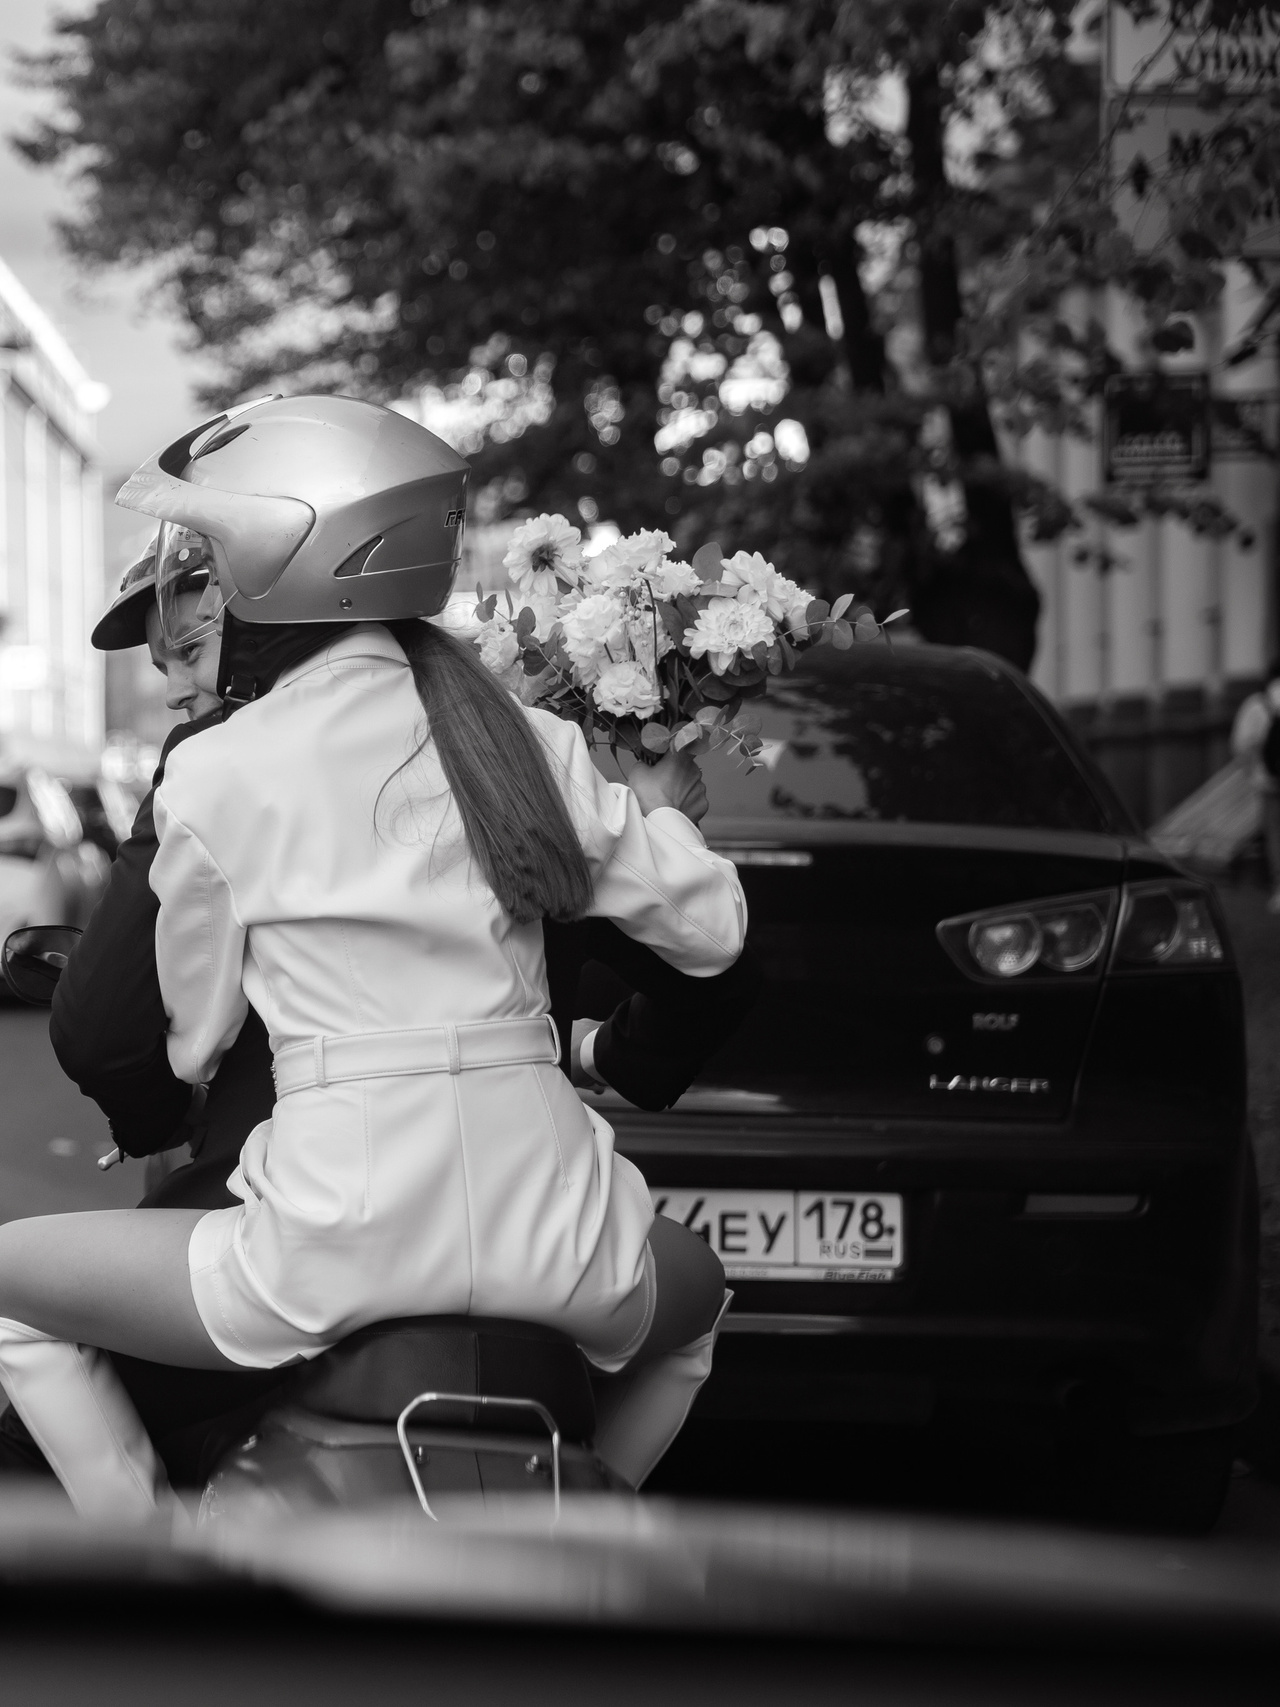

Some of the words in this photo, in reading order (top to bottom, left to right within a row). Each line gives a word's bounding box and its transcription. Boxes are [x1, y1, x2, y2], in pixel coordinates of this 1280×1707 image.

[972, 1012, 1020, 1031] ROLF
[803, 1198, 884, 1243] 178
[819, 1241, 863, 1260] RUS
